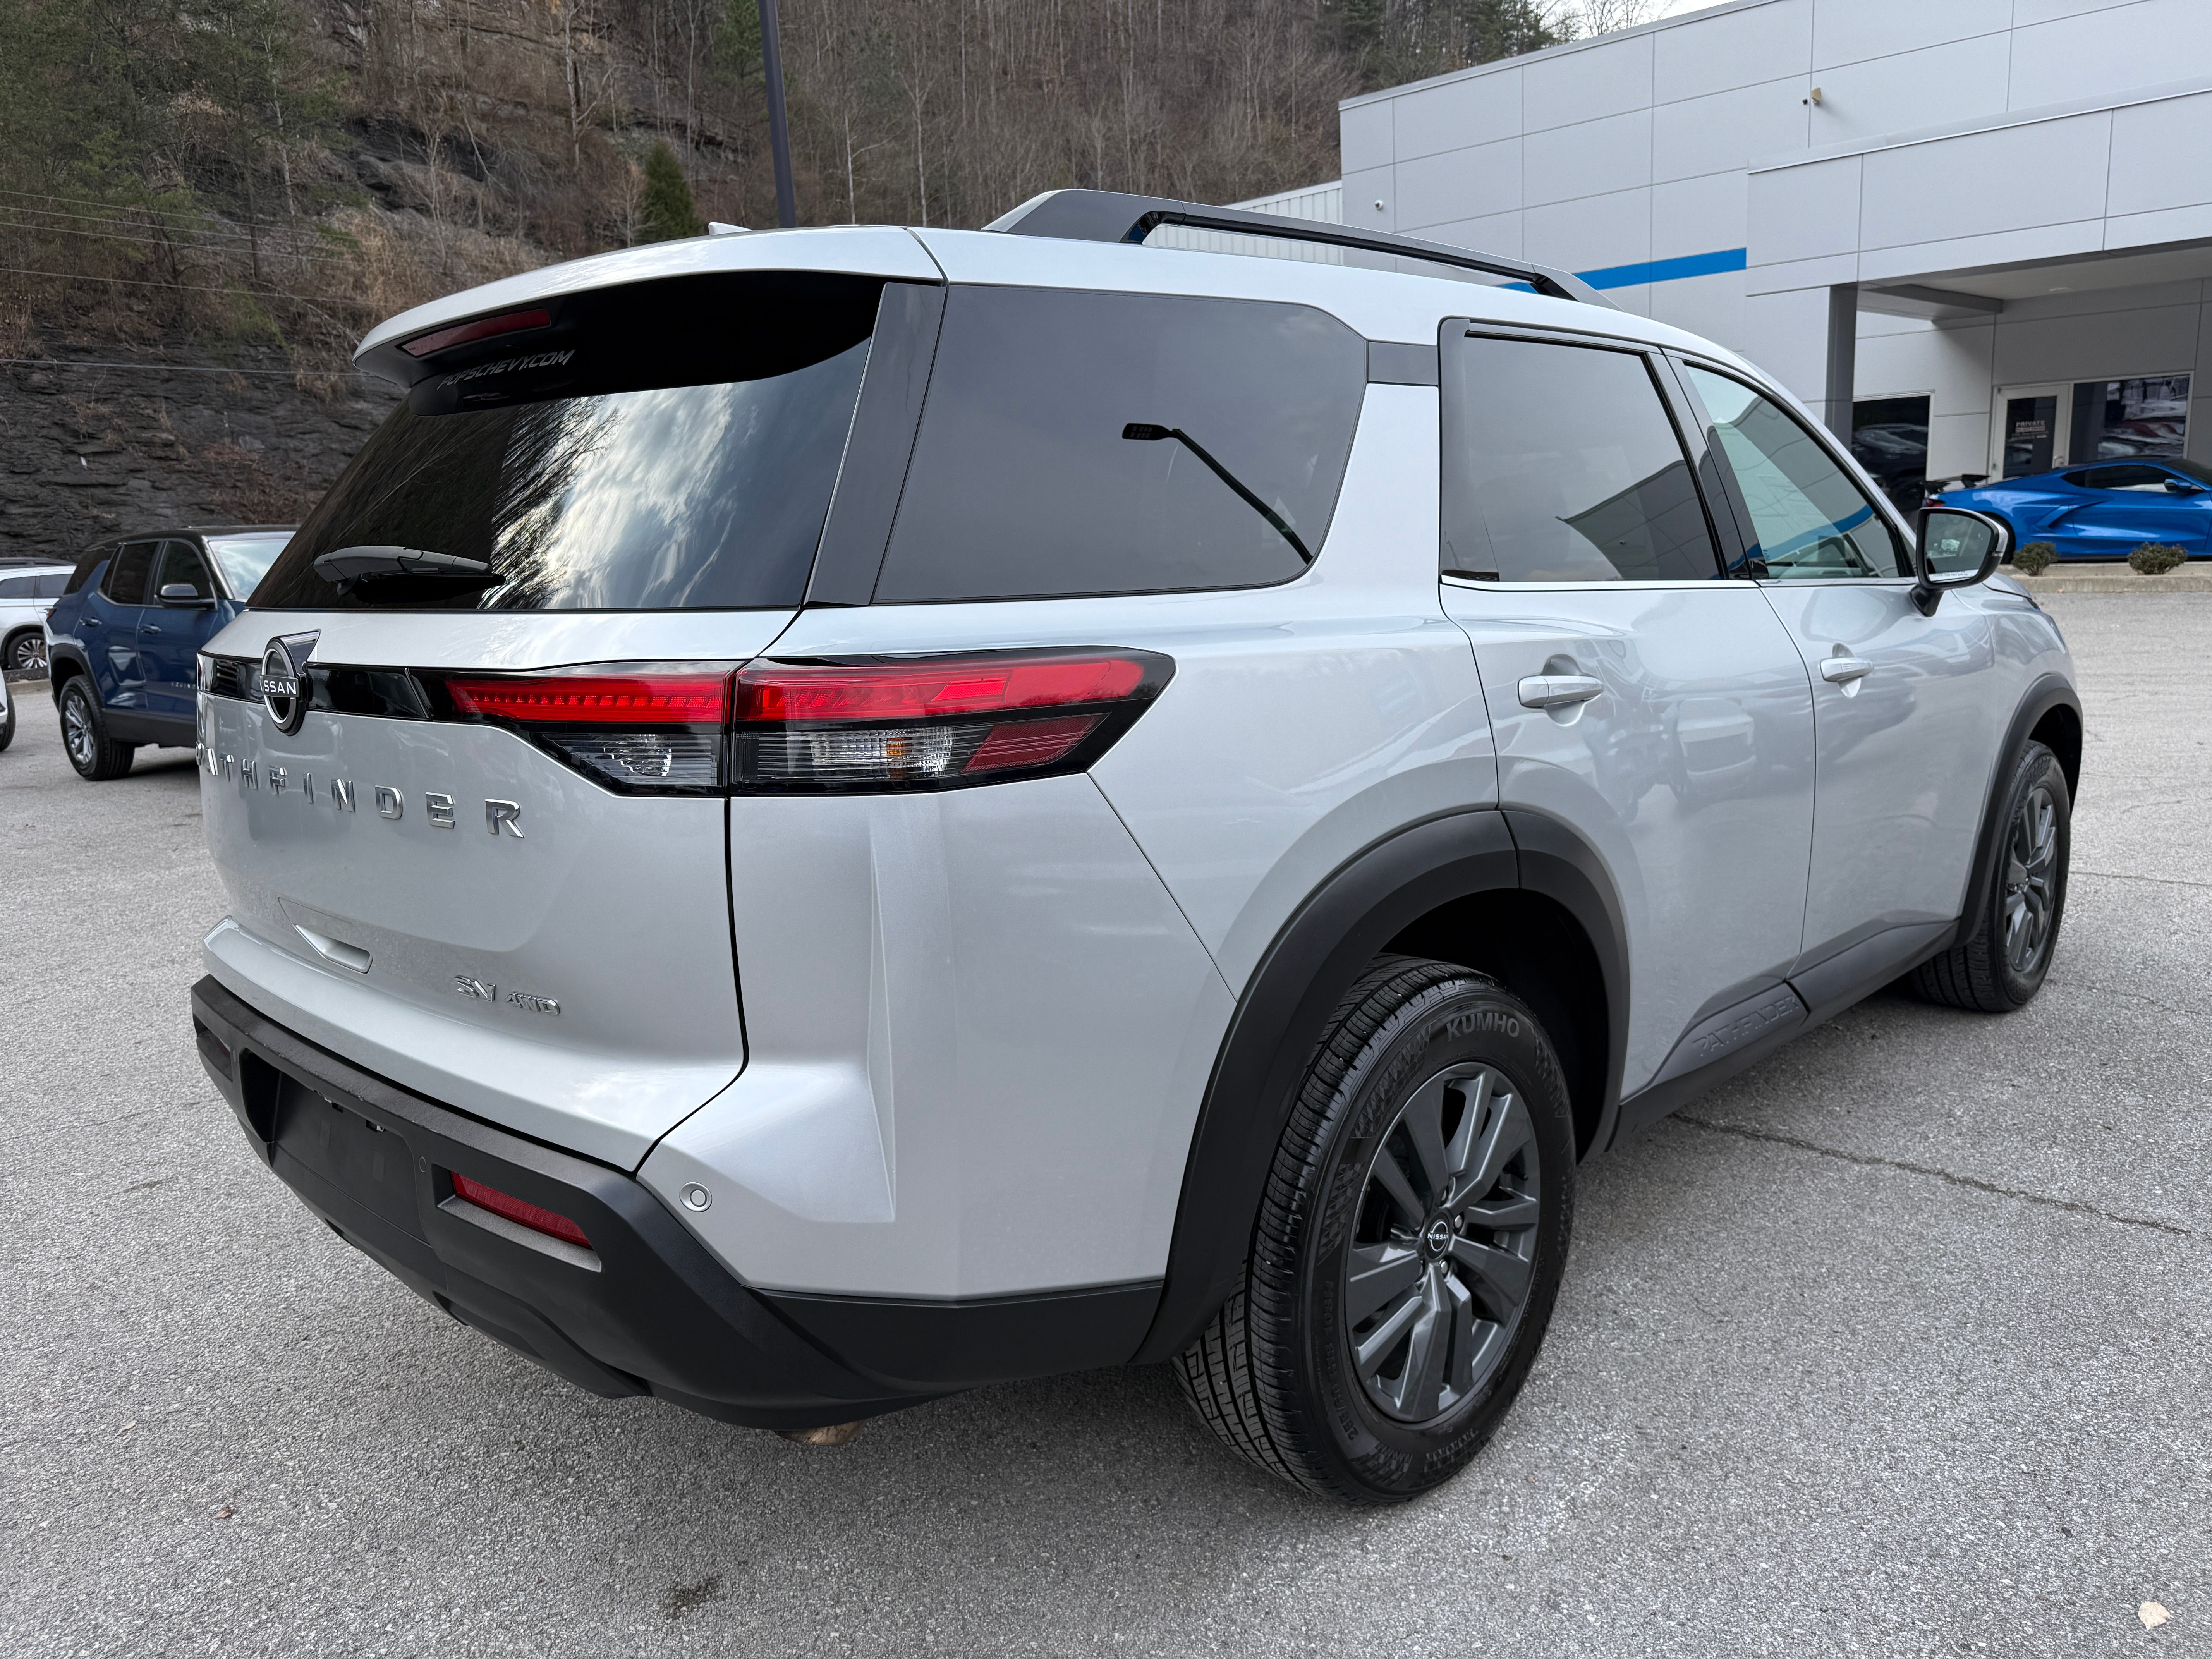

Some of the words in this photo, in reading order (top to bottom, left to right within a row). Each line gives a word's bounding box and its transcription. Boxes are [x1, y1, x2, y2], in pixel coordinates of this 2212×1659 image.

[437, 349, 576, 390] POPSCHEVY.COM
[196, 741, 524, 838] PATHFINDER
[454, 975, 496, 1002] SV
[1446, 1012, 1520, 1042] KUMHO
[1692, 994, 1800, 1057] PATHFINDER
